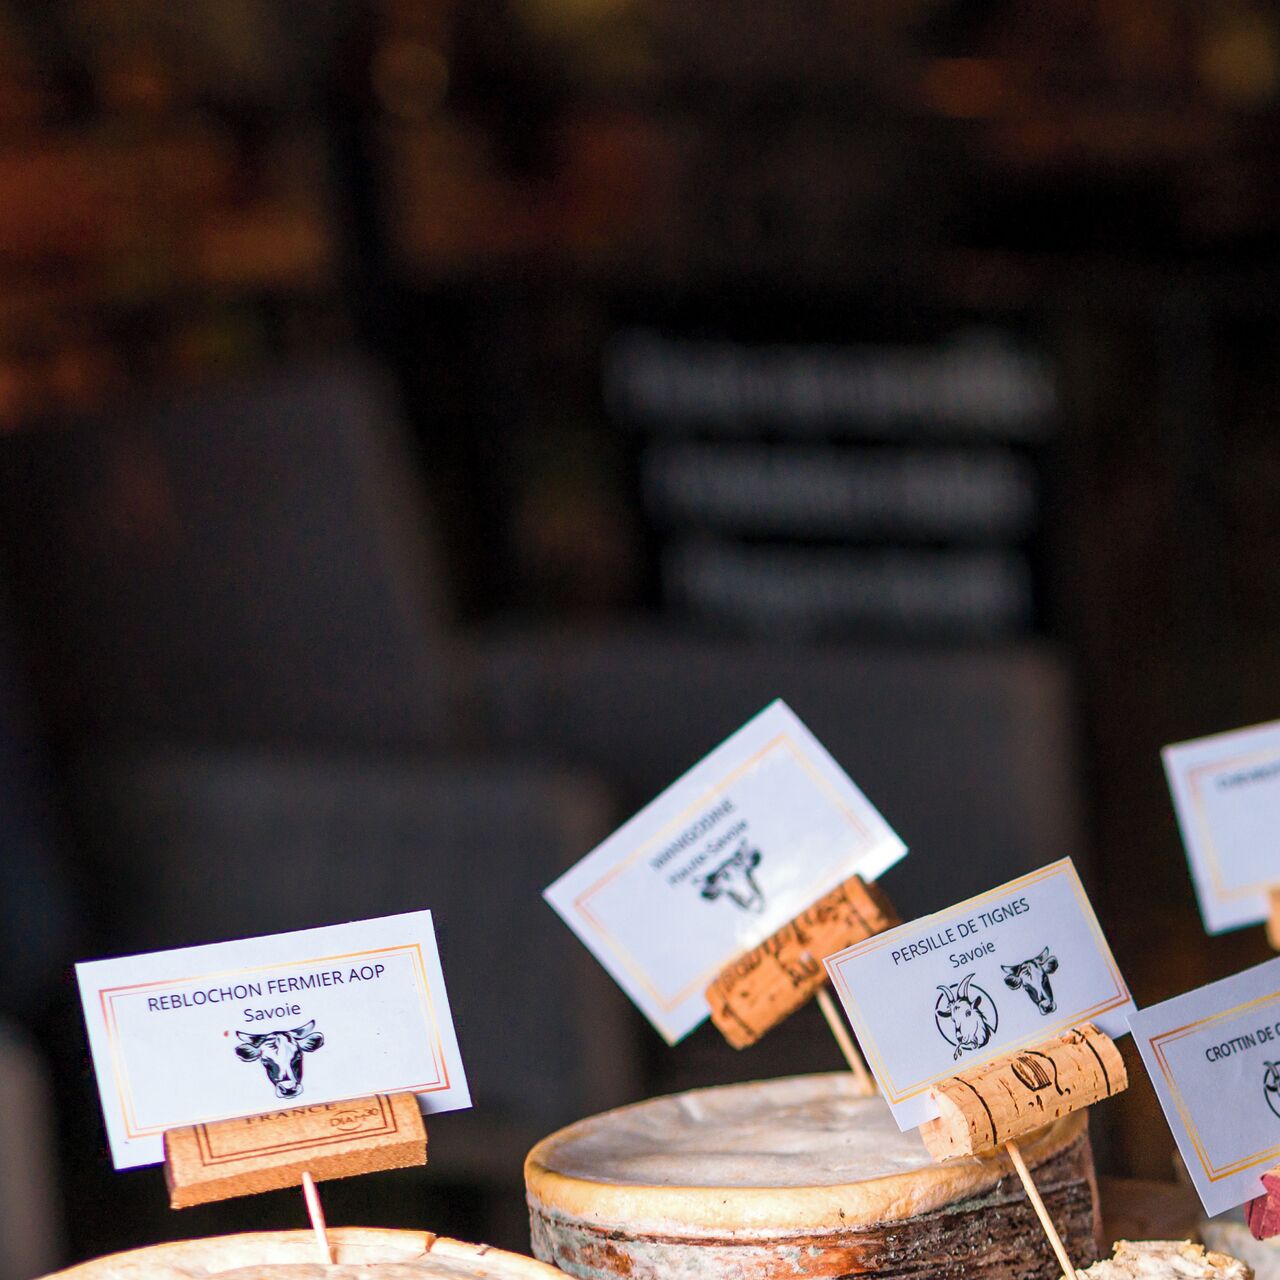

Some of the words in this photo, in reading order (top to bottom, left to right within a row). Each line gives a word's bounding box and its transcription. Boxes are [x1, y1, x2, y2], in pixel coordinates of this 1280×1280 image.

[891, 928, 956, 966] PERSILLE
[957, 919, 977, 938] DE
[978, 897, 1031, 929] TIGNES
[949, 940, 997, 969] Savoie
[147, 984, 262, 1013] REBLOCHON
[268, 970, 345, 995] FERMIER
[348, 964, 386, 984] AOP
[244, 1002, 301, 1023] Savoie
[1205, 1034, 1256, 1062] CROTTIN
[1257, 1027, 1275, 1043] DE
[245, 1103, 338, 1126] FRANCE
